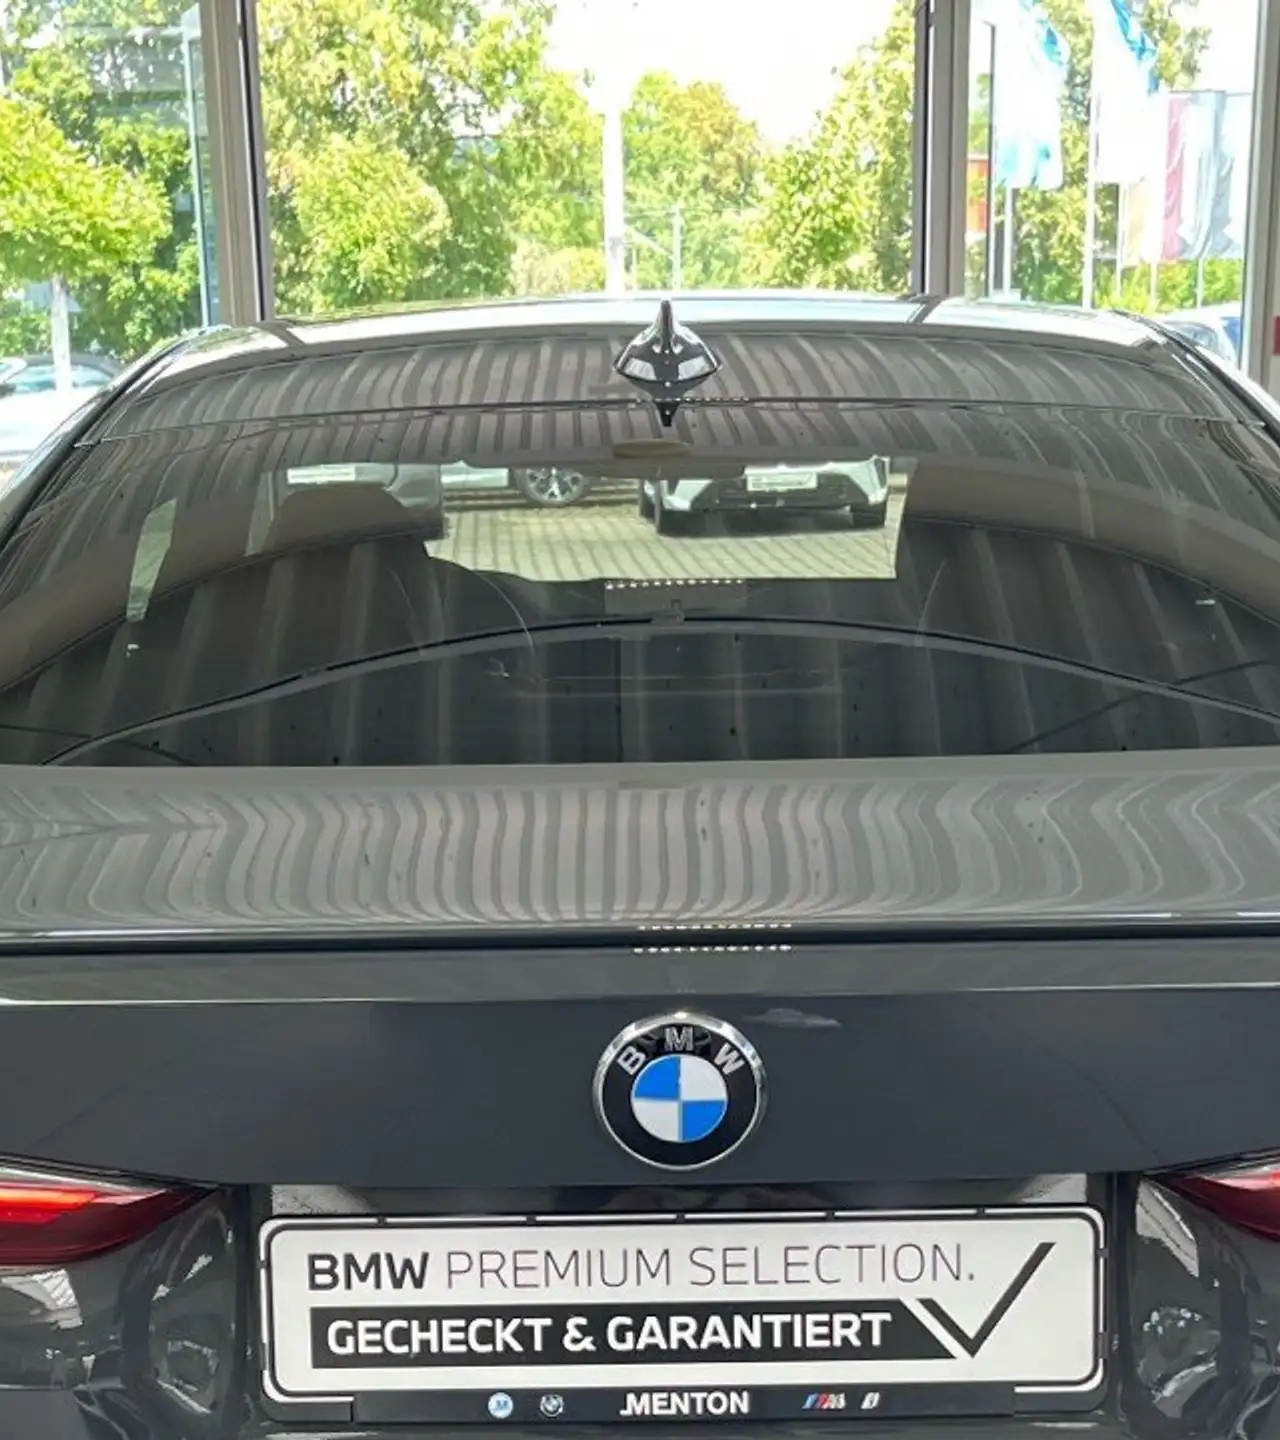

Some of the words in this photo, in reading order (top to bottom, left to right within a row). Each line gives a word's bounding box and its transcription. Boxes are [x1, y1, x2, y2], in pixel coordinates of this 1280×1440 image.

[617, 1026, 745, 1076] BMW
[307, 1251, 430, 1291] BMW
[446, 1247, 671, 1289] PREMIUM
[689, 1241, 976, 1286] SELECTION.
[327, 1317, 552, 1355] GECHECKT
[562, 1315, 597, 1352] &
[607, 1311, 892, 1352] GARANTIERT
[619, 1390, 750, 1417] MENTON
